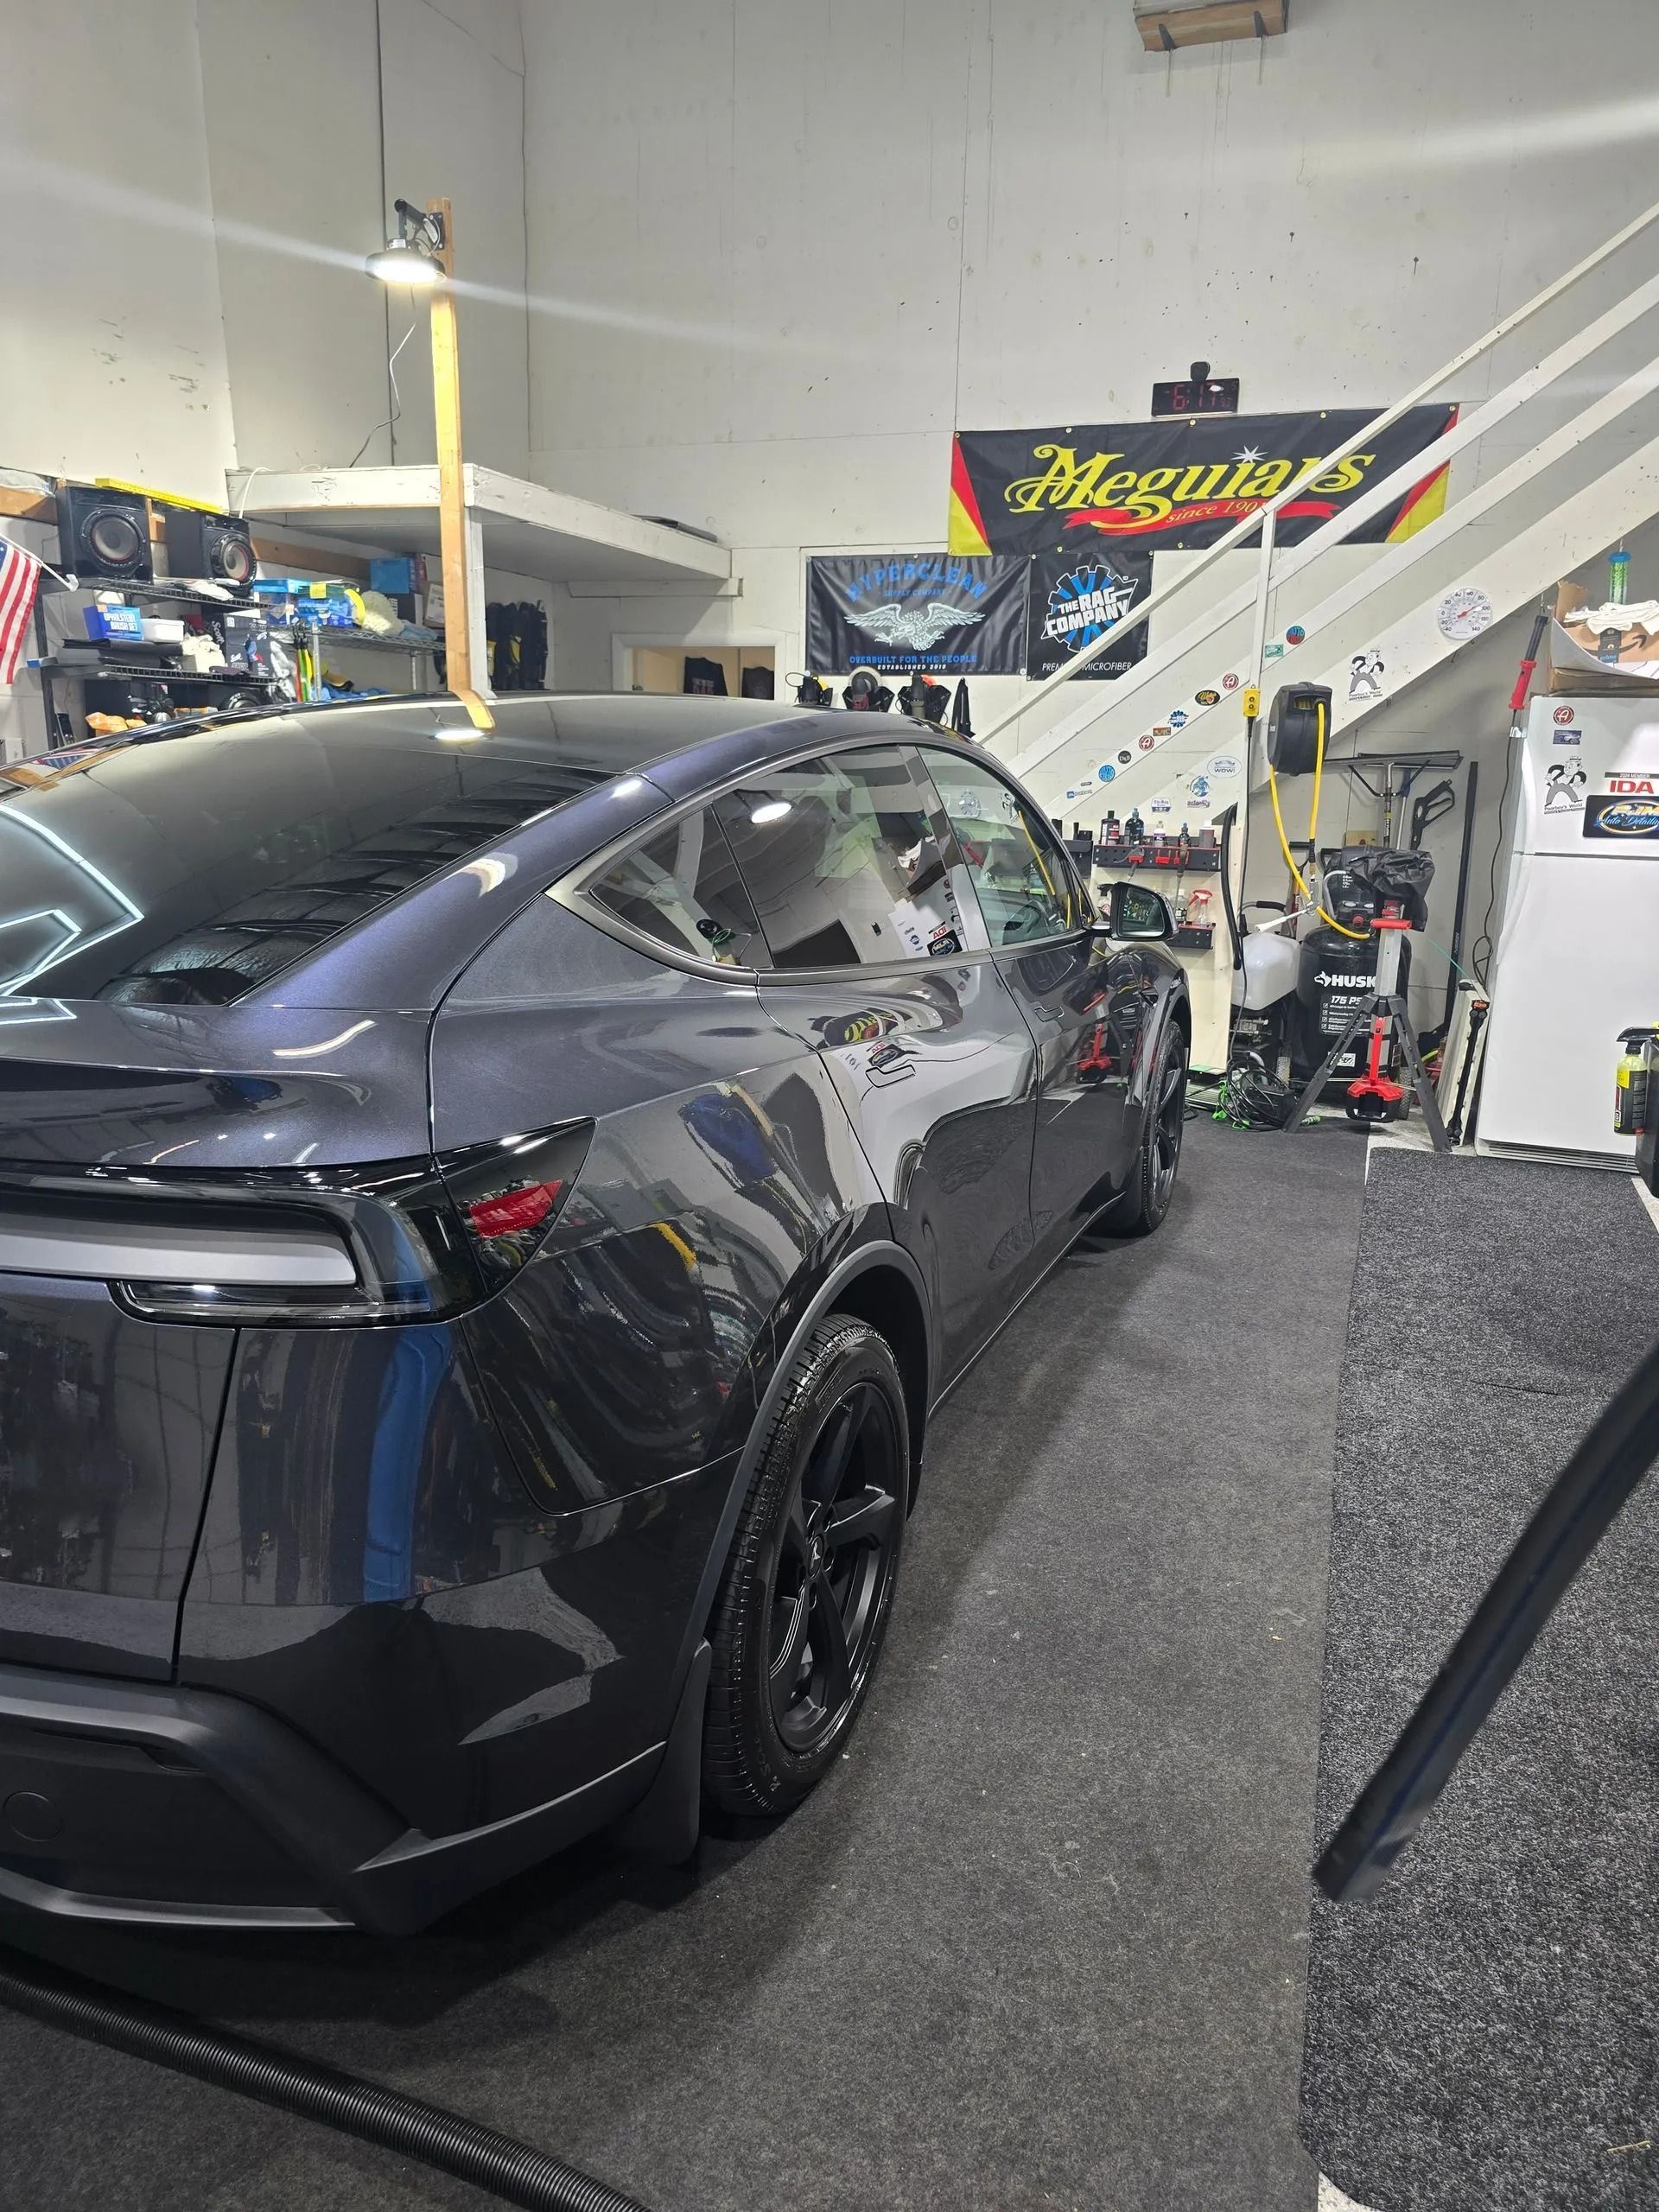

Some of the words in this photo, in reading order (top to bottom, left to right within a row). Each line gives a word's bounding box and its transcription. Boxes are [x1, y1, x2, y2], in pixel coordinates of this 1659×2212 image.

[1166, 505, 1217, 523] since
[844, 562, 988, 602] HYPERCLEAN
[912, 588, 946, 596] COMPANY
[1058, 601, 1079, 613] THE
[1078, 587, 1134, 612] RAG
[1046, 599, 1128, 636] COMPANY
[899, 655, 917, 664] FOR
[920, 655, 939, 664] THE
[941, 655, 977, 664] PEOPLE
[1610, 780, 1654, 794] IDA
[1331, 975, 1376, 988] HUSK
[1331, 995, 1347, 1004] 175
